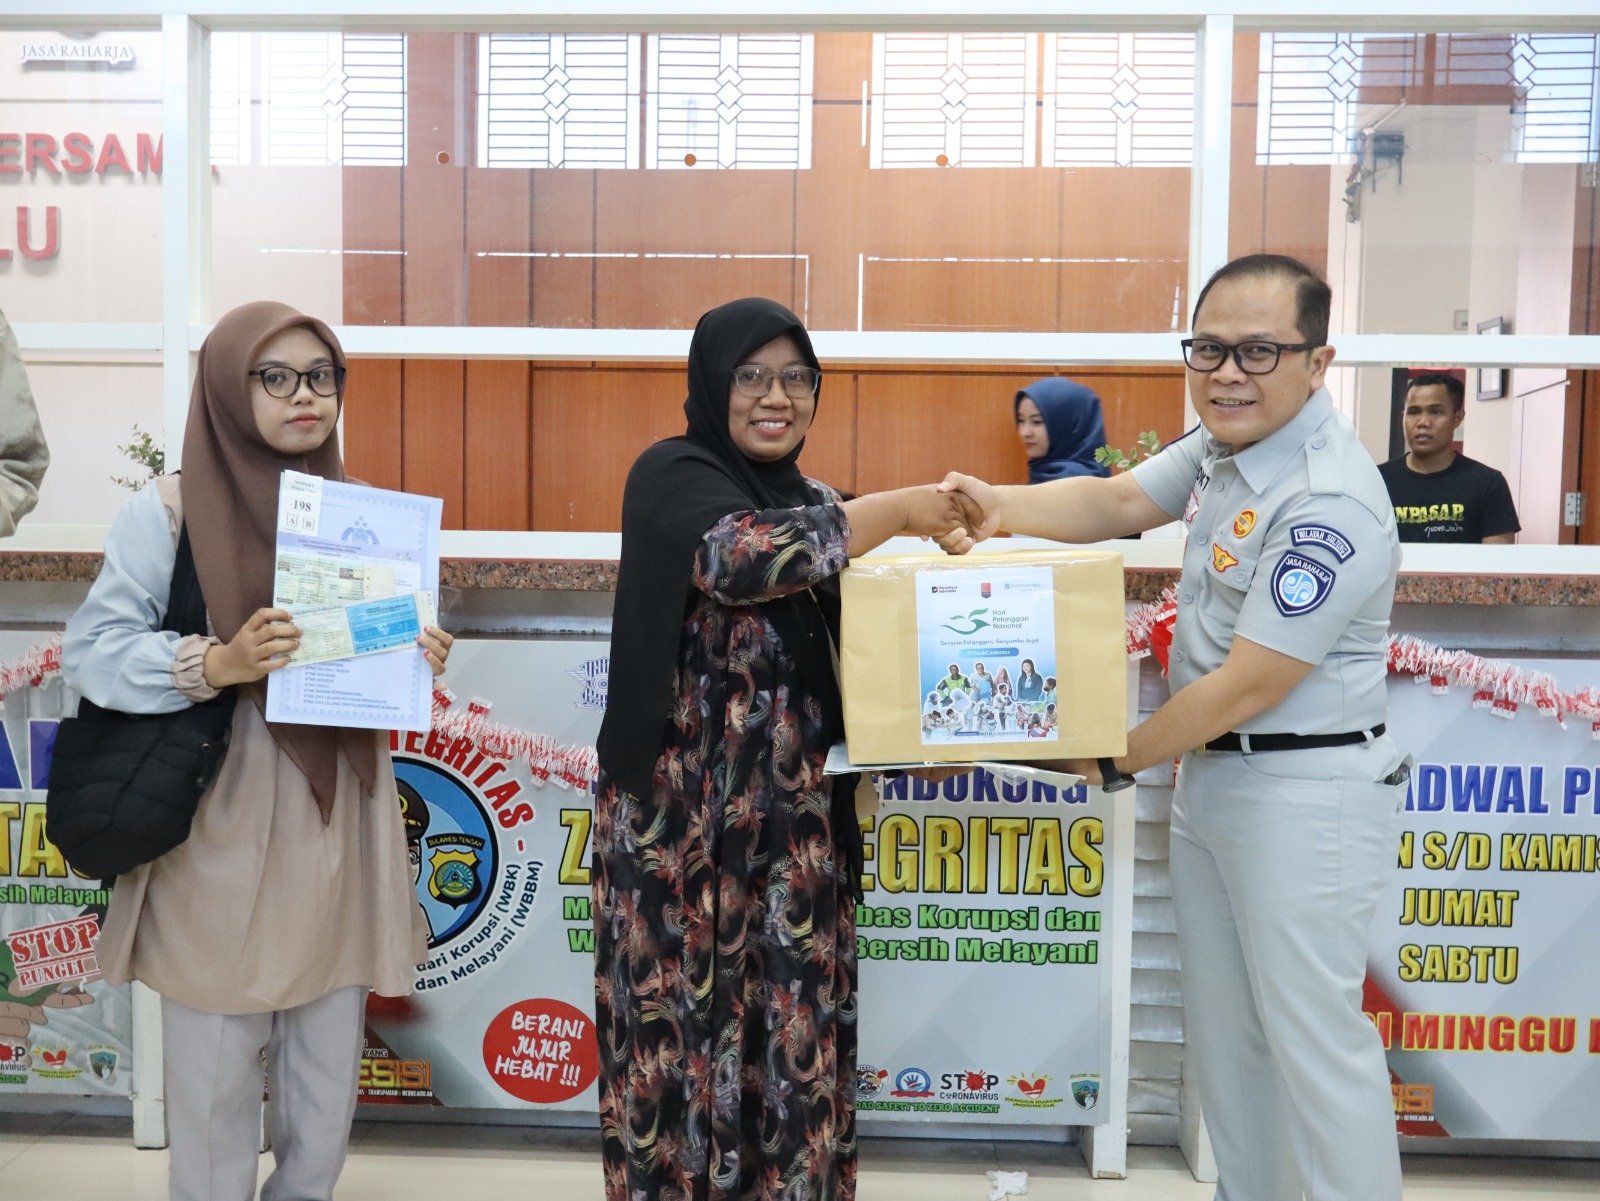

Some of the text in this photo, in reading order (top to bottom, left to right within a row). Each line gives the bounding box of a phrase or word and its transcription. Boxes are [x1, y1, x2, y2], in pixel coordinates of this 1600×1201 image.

[20, 45, 130, 60] JASA RAHARJA
[0, 133, 164, 174] ERSAM
[0, 206, 59, 261] U
[293, 500, 312, 512] 198
[1298, 529, 1349, 556] WILAYAH SULTENG
[1285, 557, 1330, 583] JASA RAHARJA
[992, 616, 1029, 624] Pelanggan
[872, 766, 1089, 804] NDUKUNG
[0, 802, 100, 880] TA
[428, 836, 483, 847] SULAWESI TENGAH
[1422, 830, 1491, 870] S/D
[1500, 833, 1600, 873] KAMI
[29, 884, 113, 907] Melayani
[495, 863, 522, 913] (WBK)
[511, 860, 544, 928] (WBBM)
[917, 904, 1040, 932] Korupsi
[1045, 907, 1102, 931] dan
[1399, 887, 1519, 928] JUMAT
[10, 920, 98, 964] STOP
[450, 913, 501, 961] Korupsi
[857, 935, 1099, 966] Bersih Melayani
[415, 926, 516, 991] dan Melayani
[1399, 943, 1519, 984] SABTU
[511, 1010, 585, 1040] BERANI
[1402, 1012, 1577, 1055] MINGGU
[364, 1048, 389, 1058] YANG
[512, 1035, 571, 1061] JUJUR
[494, 1054, 559, 1083] HEBAT
[940, 1071, 999, 1091] STOP
[875, 1102, 911, 1111] SAFETY
[912, 1102, 927, 1112] TO
[926, 1103, 953, 1112] ZERO
[952, 1104, 1000, 1114] ACCIDENT
